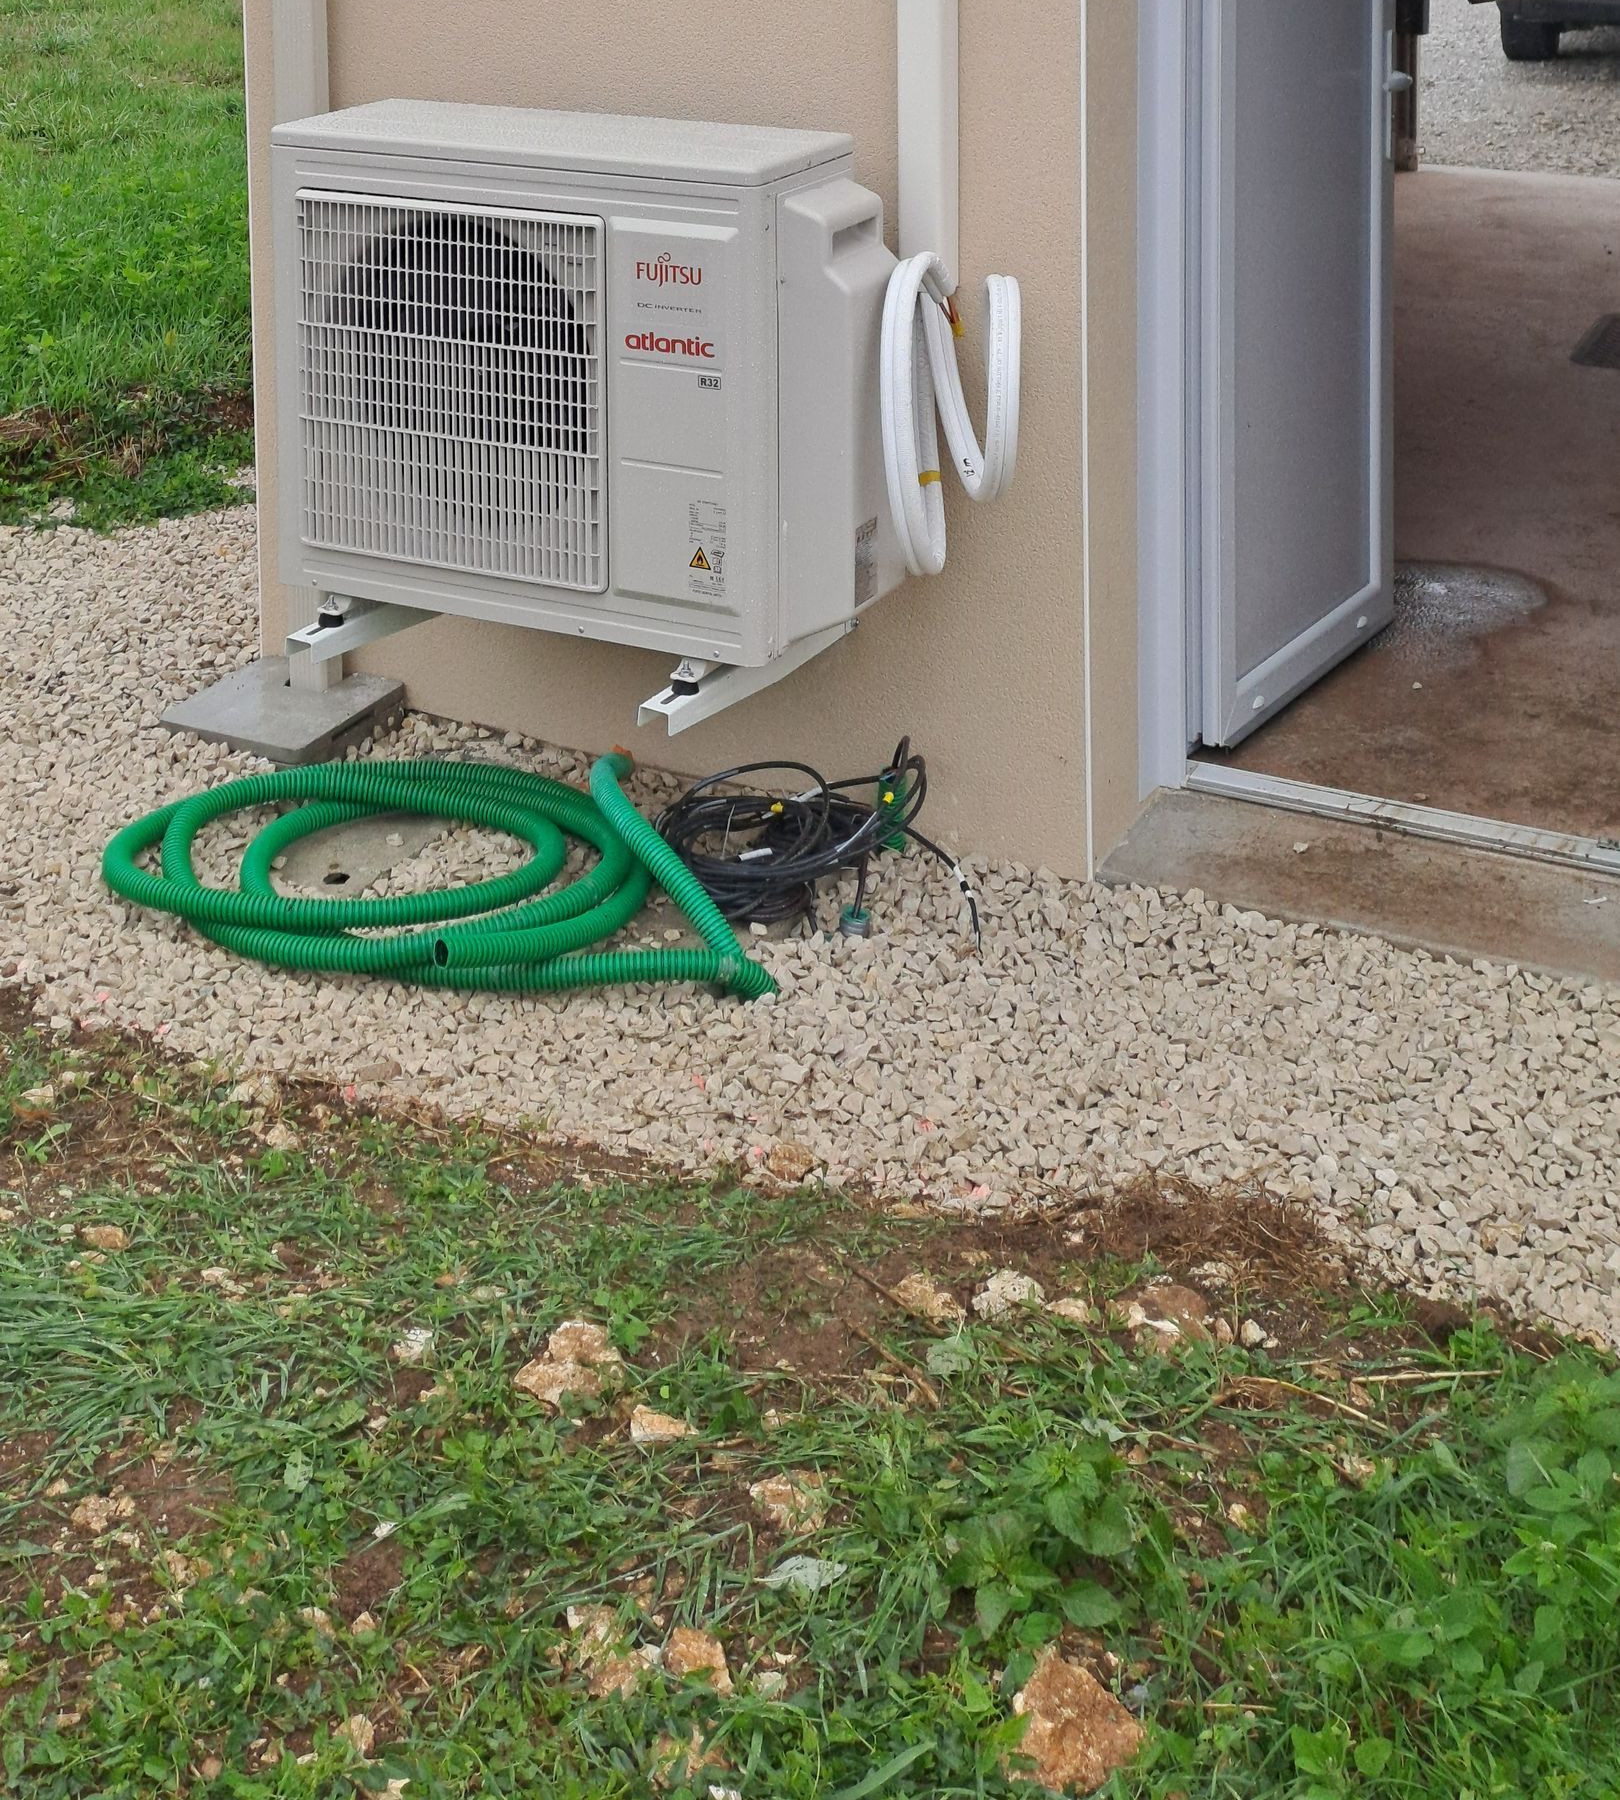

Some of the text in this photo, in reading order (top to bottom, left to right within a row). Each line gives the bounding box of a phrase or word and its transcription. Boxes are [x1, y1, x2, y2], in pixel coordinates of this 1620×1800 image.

[636, 260, 702, 287] FUJITSU
[654, 304, 702, 313] INVERTER
[625, 332, 715, 358] atlantic
[700, 378, 719, 388] R32
